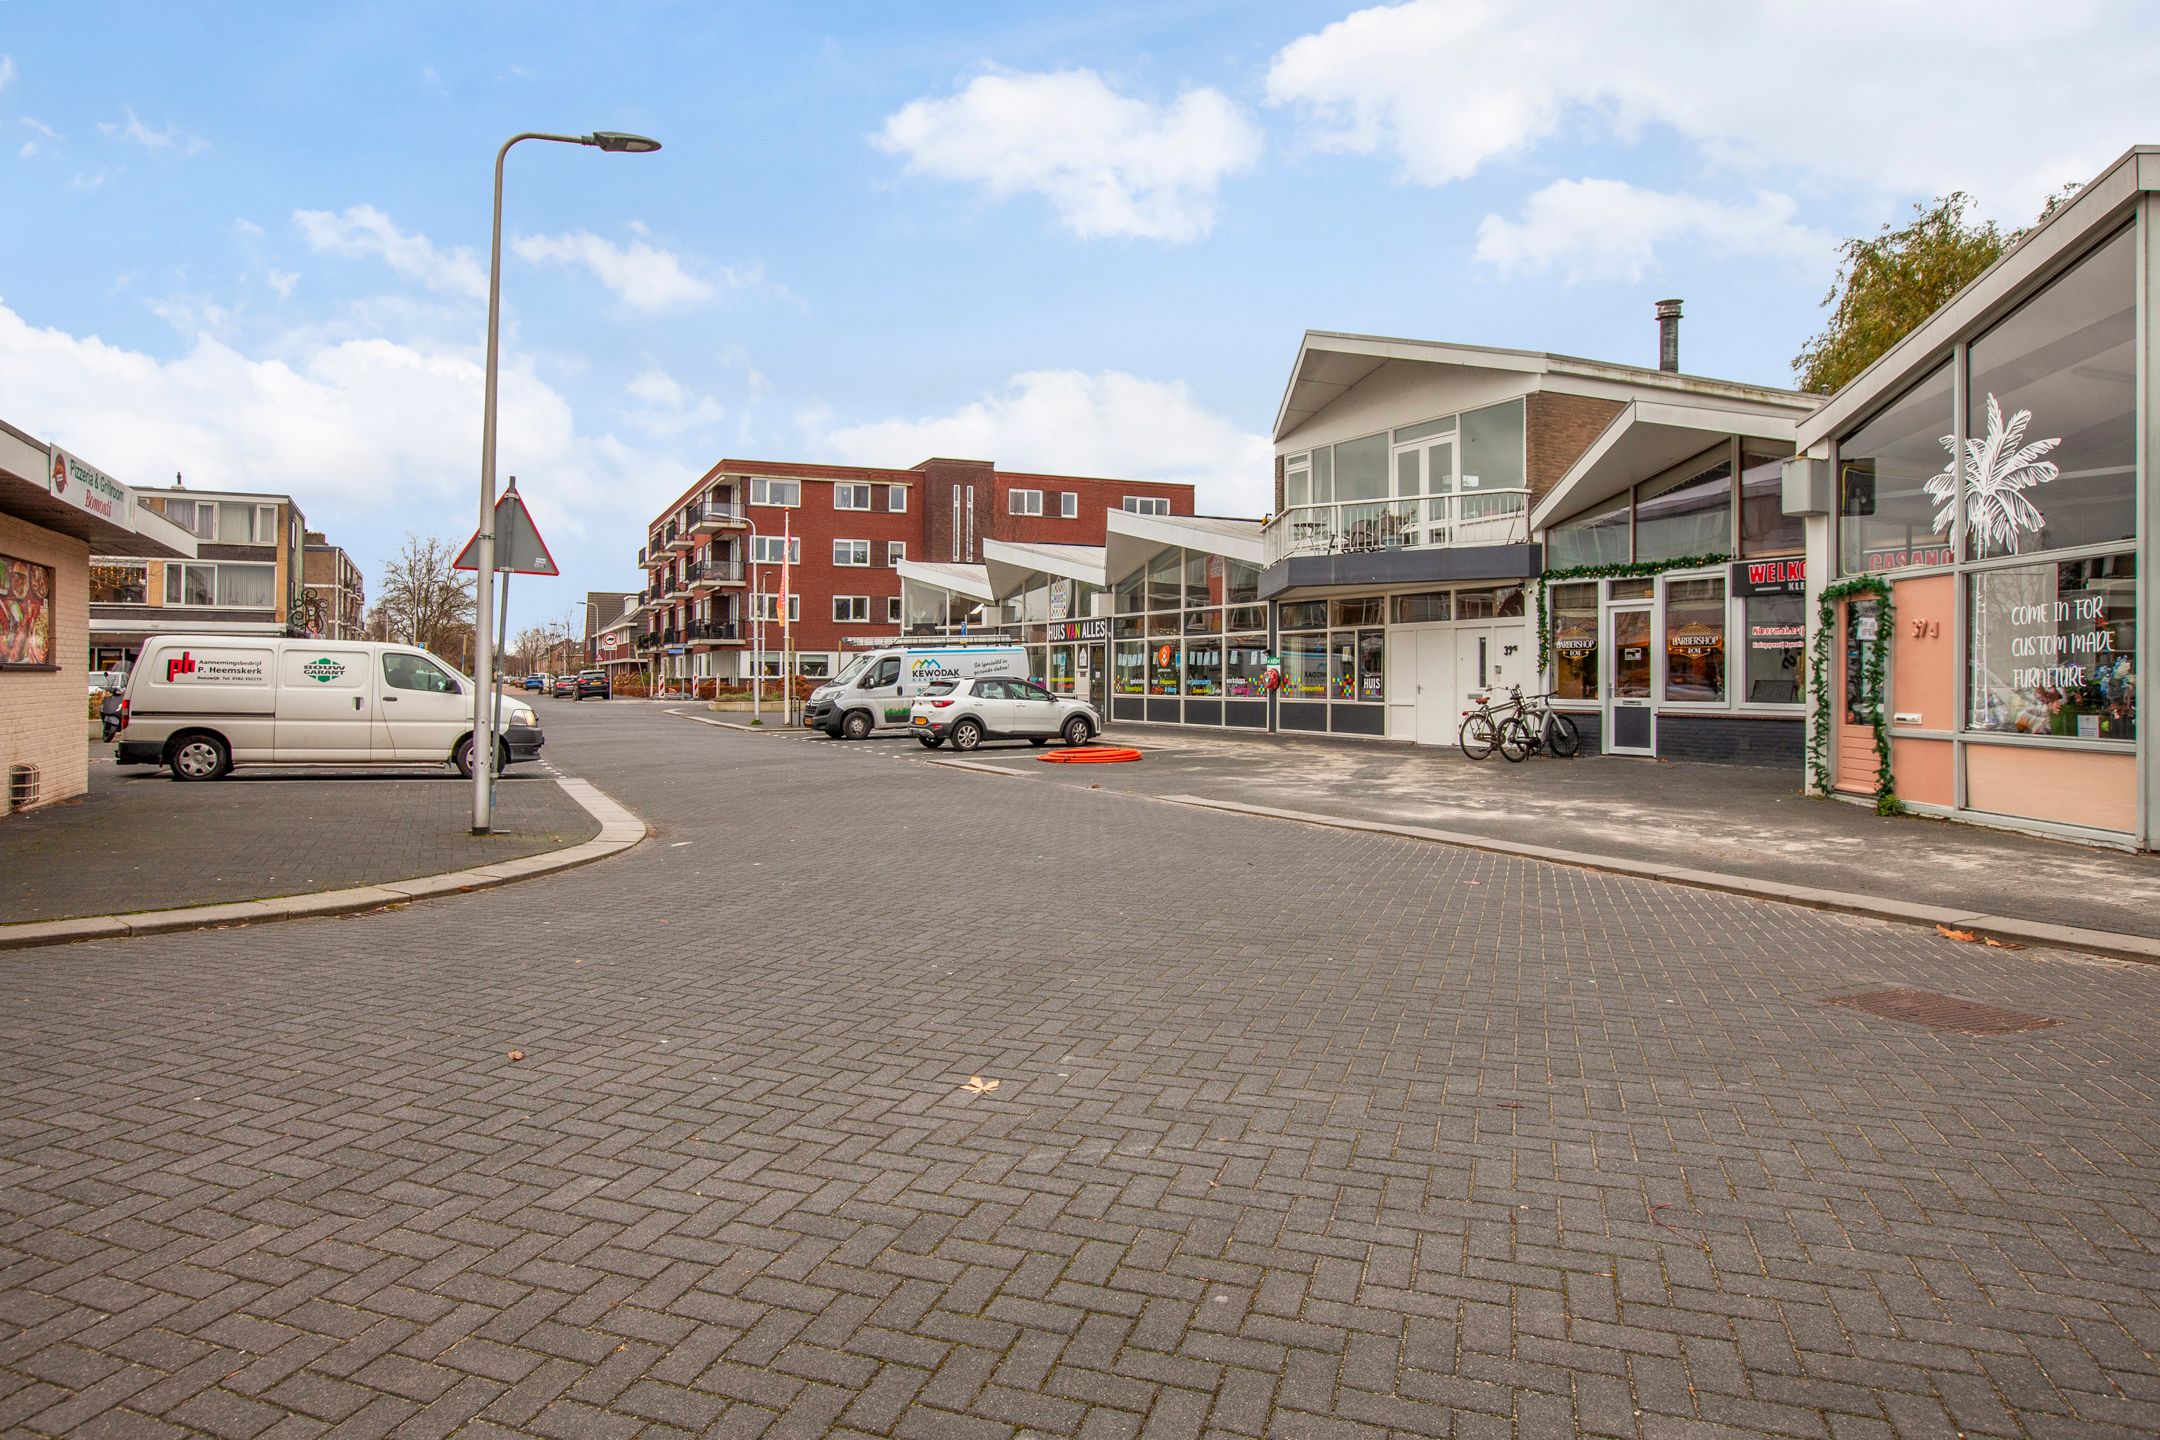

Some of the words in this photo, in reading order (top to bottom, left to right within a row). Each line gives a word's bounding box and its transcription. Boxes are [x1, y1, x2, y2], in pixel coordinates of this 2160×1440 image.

[70, 459, 93, 486] Pizzeria
[94, 473, 98, 489] &
[2012, 603, 2049, 626] COME
[2054, 600, 2070, 622] IN
[2074, 596, 2104, 620] FOR
[1048, 624, 1066, 640] HUIS
[1066, 623, 1080, 639] VAN
[1082, 620, 1105, 638] ALLES
[1672, 636, 1718, 646] BARBERSHOP
[2012, 636, 2066, 656] CUSTOM
[2071, 630, 2115, 654] MADE
[210, 666, 262, 674] Heemskerk
[912, 669, 960, 677] KEWODAK
[2013, 666, 2086, 688] FURNITURE
[1364, 678, 1380, 689] HUIS
